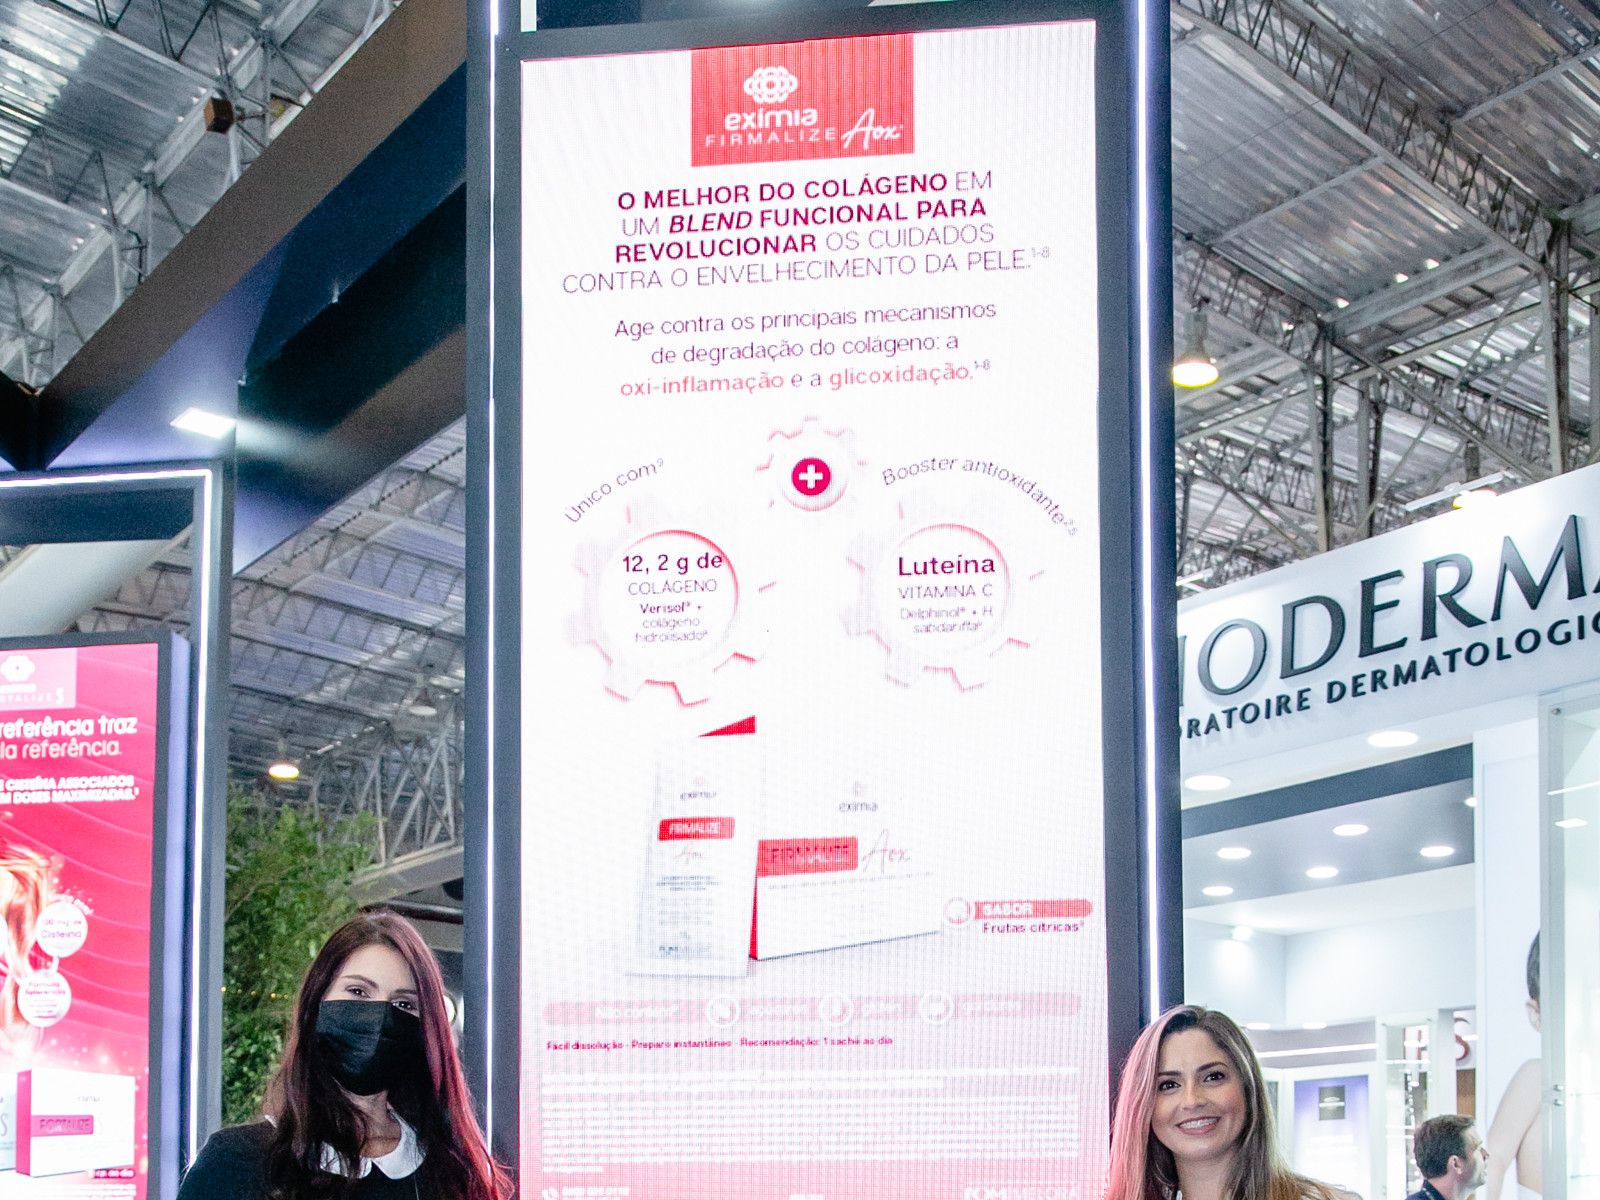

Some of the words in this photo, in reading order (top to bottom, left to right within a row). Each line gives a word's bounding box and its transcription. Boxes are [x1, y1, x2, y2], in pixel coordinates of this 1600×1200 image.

[724, 107, 818, 131] exímia
[705, 127, 837, 148] FIRMALIZE
[618, 192, 636, 211] O
[644, 185, 750, 208] MELHOR
[760, 182, 794, 202] DO
[804, 172, 947, 200] COLÁGENO
[955, 171, 992, 192] EM
[622, 217, 660, 237] UM
[669, 212, 752, 234] BLEND
[760, 202, 908, 228] FUNCIONAL
[917, 198, 986, 219] PARA
[615, 234, 816, 263] REVOLUCIONAR
[825, 231, 859, 251] OS
[869, 224, 994, 249] CUIDADOS
[563, 269, 662, 293] CONTRA
[672, 269, 688, 288] O
[697, 255, 915, 287] ENVELHECIMENTO
[926, 254, 958, 275] DA
[615, 320, 654, 339] Age
[661, 313, 724, 334] contra
[731, 316, 754, 330] os
[761, 308, 857, 335] principais
[864, 302, 996, 324] mecanismos
[651, 345, 676, 364] de
[683, 338, 804, 365] degradação
[810, 338, 835, 357] do
[842, 333, 941, 359] colágeno:
[946, 334, 959, 350] a
[620, 371, 783, 397] oxi-inflamação
[791, 372, 804, 387] e
[810, 371, 822, 387] a
[882, 457, 958, 486] Booster
[623, 555, 649, 574] 12,
[658, 554, 668, 571] 2
[677, 557, 688, 575] g
[697, 553, 722, 569] de
[899, 554, 995, 576] Luteína
[898, 585, 975, 600] VITAMINA
[982, 584, 993, 597] C
[1178, 514, 1600, 707] ODERM
[643, 616, 700, 630] colágeno
[98, 716, 138, 734] traz
[1180, 688, 1312, 739] RATOIRE
[58, 775, 134, 789] ASSOCIADOS
[983, 903, 1033, 915] SABOR
[983, 921, 1025, 933] Frutas
[571, 1040, 623, 1052] dissolução
[631, 1040, 671, 1050] Preparo
[878, 1036, 893, 1045] dia
